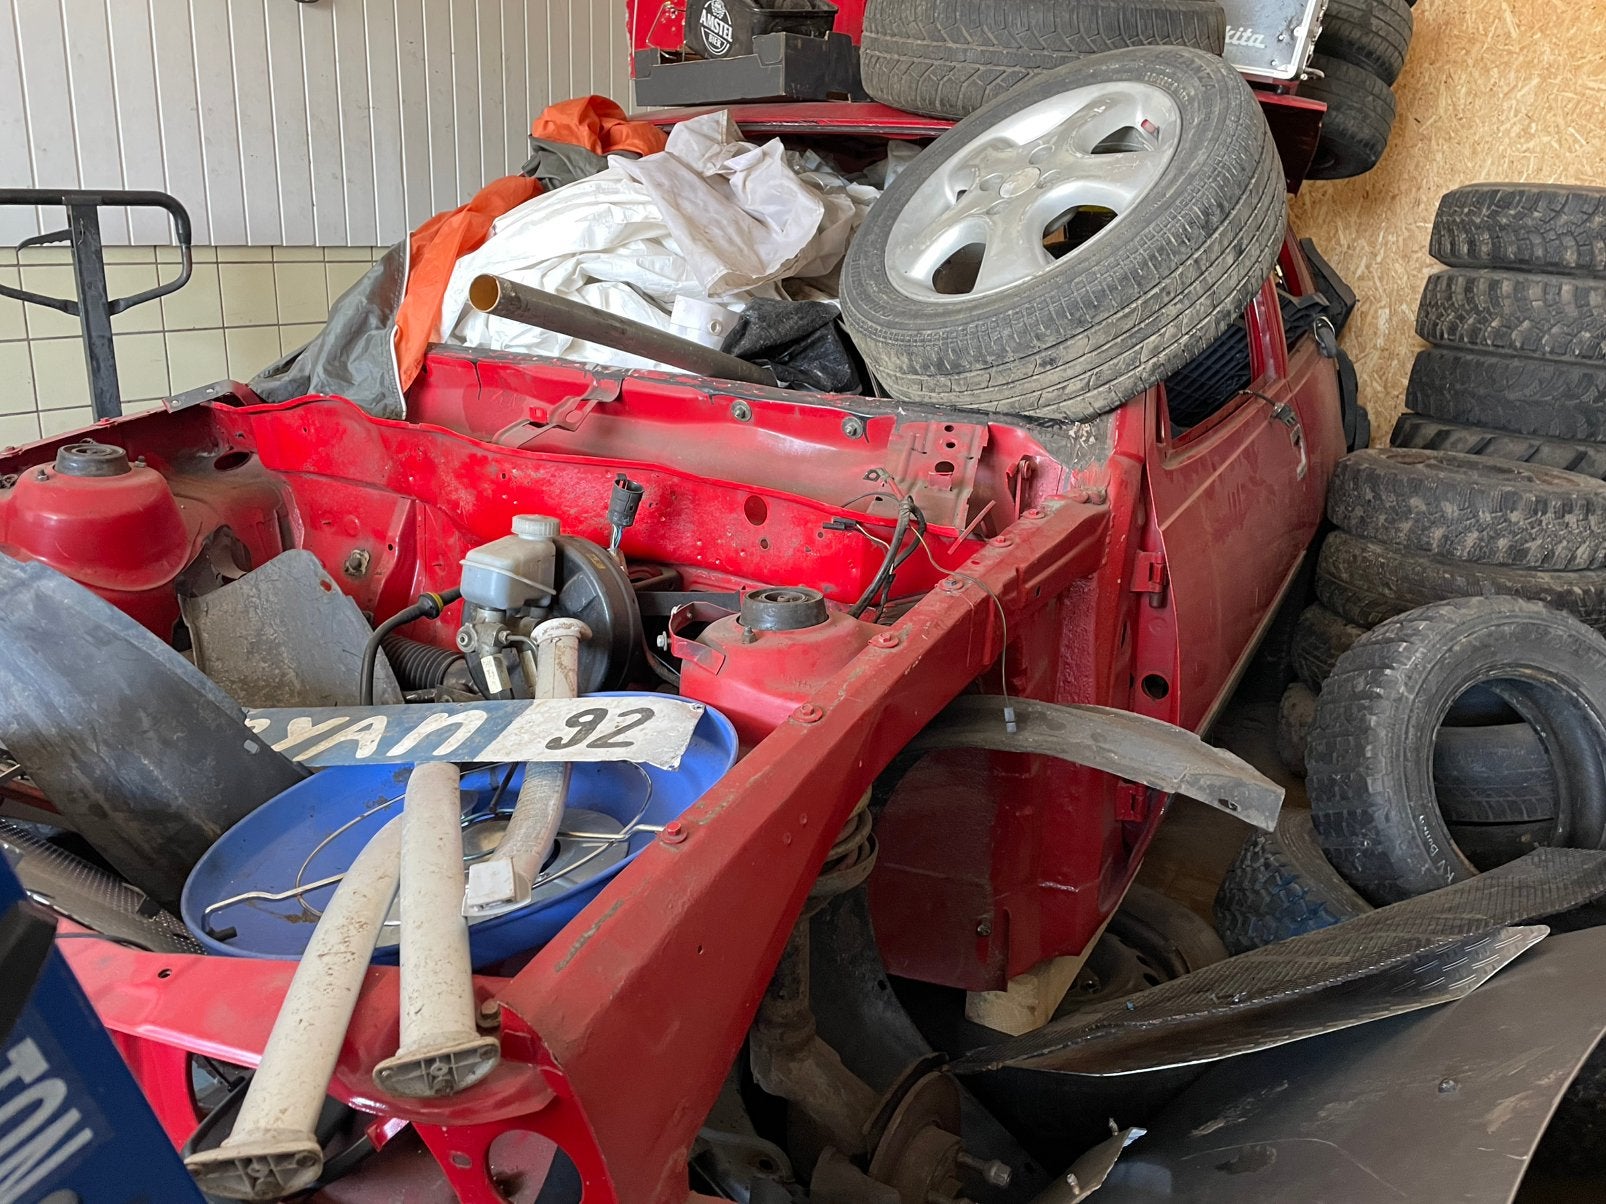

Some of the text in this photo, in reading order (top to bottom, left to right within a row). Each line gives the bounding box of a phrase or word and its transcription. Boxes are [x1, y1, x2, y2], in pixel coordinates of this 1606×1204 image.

[700, 8, 733, 42] AMSTEL
[1225, 25, 1265, 48] kita
[708, 34, 722, 48] BIER
[545, 707, 655, 750] 92
